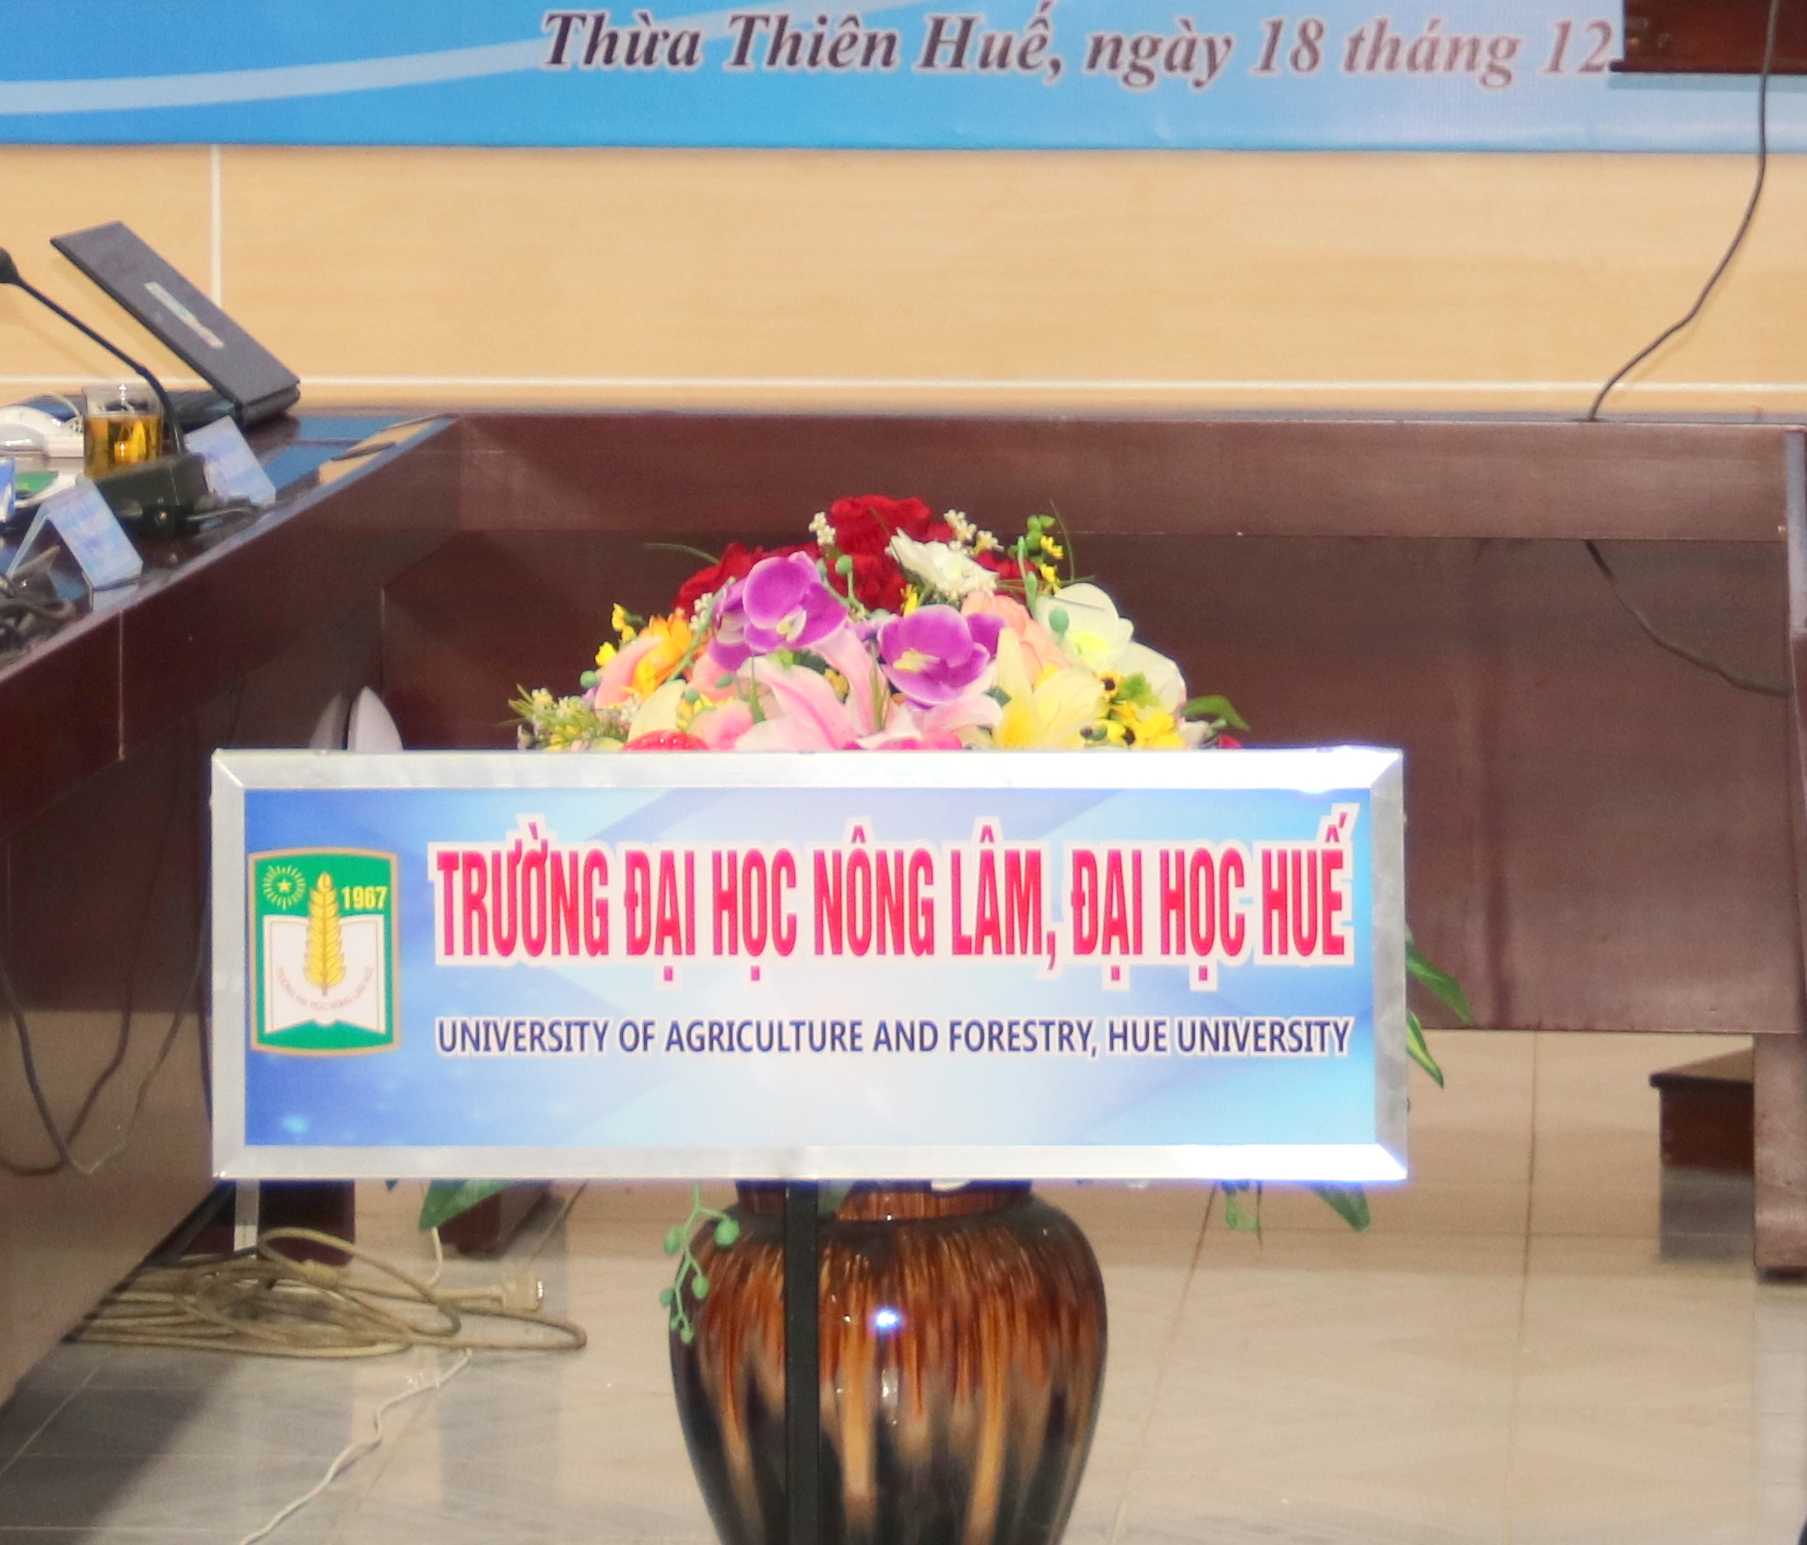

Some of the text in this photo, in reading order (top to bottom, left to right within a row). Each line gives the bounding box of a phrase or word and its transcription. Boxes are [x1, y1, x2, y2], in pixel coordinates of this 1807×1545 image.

[542, 11, 702, 67] Thừa
[726, 13, 897, 71] Thiên
[919, 0, 1063, 82] Huế,
[1085, 21, 1233, 90] ngày
[1251, 17, 1325, 74] 18
[1343, 17, 1520, 87] tháng
[341, 886, 387, 909] 1967
[437, 812, 1348, 982] TRƯỜNG ĐẠI HỌC NÔNG LÂM, ĐẠI HỌC HUẾ
[438, 1020, 1350, 1057] UNIVERSITY OF AGRICULTURE AND FORESTRY, HUE UNIVERSITY
